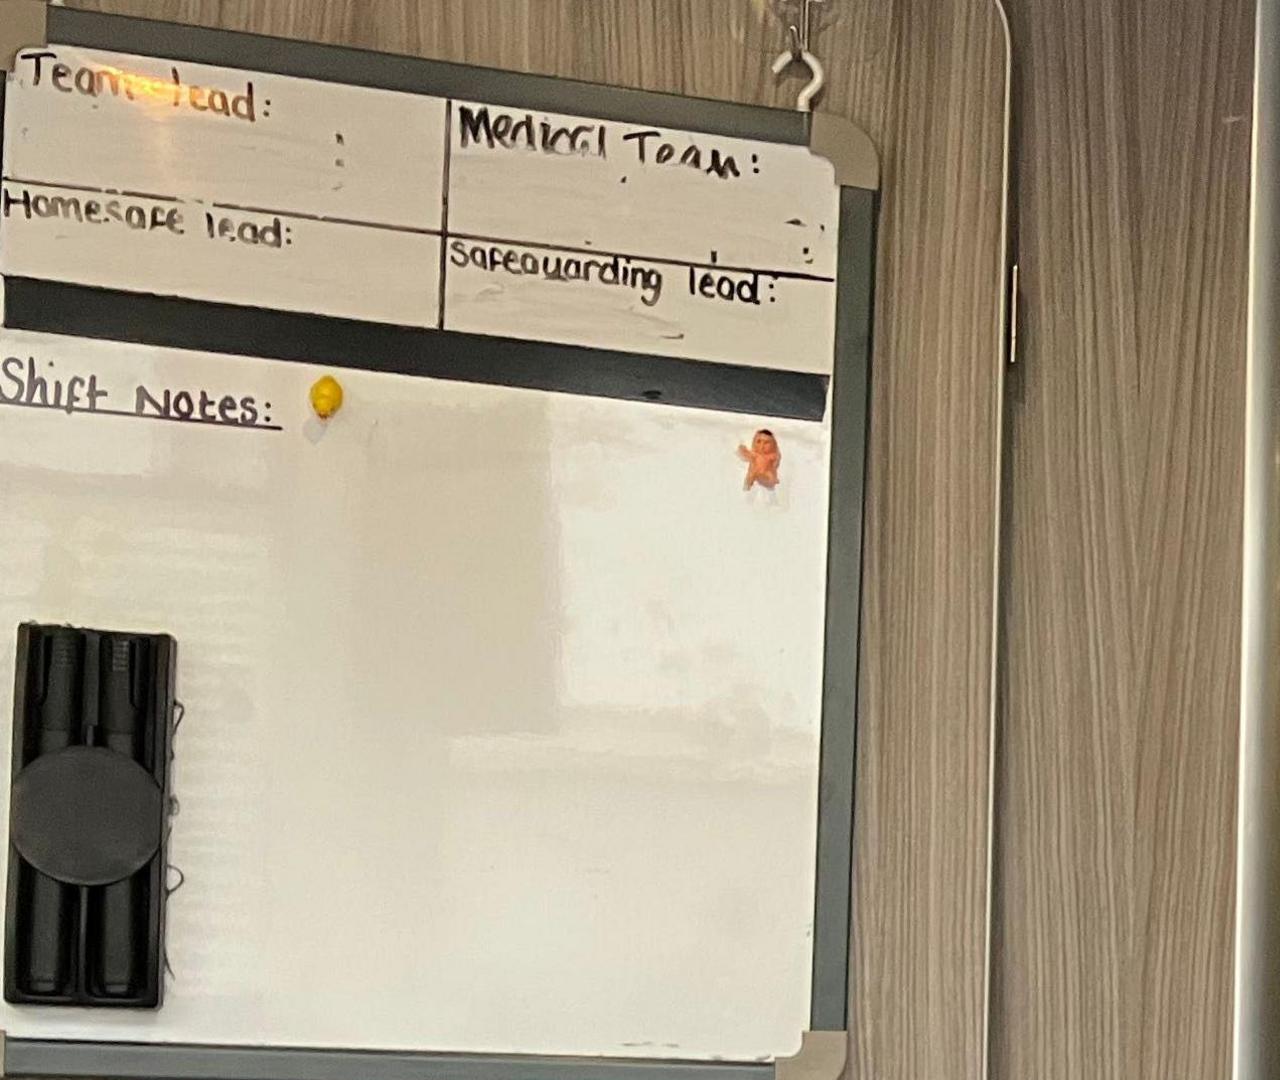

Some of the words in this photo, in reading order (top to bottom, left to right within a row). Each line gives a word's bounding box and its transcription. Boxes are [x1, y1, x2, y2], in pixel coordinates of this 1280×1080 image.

[171, 66, 271, 123] lead:
[459, 106, 607, 160] Medical
[623, 130, 761, 179] Team:
[205, 212, 293, 249] lead:
[689, 264, 776, 306] lead:
[0, 356, 108, 414] Shift
[135, 384, 272, 425] Notes:
